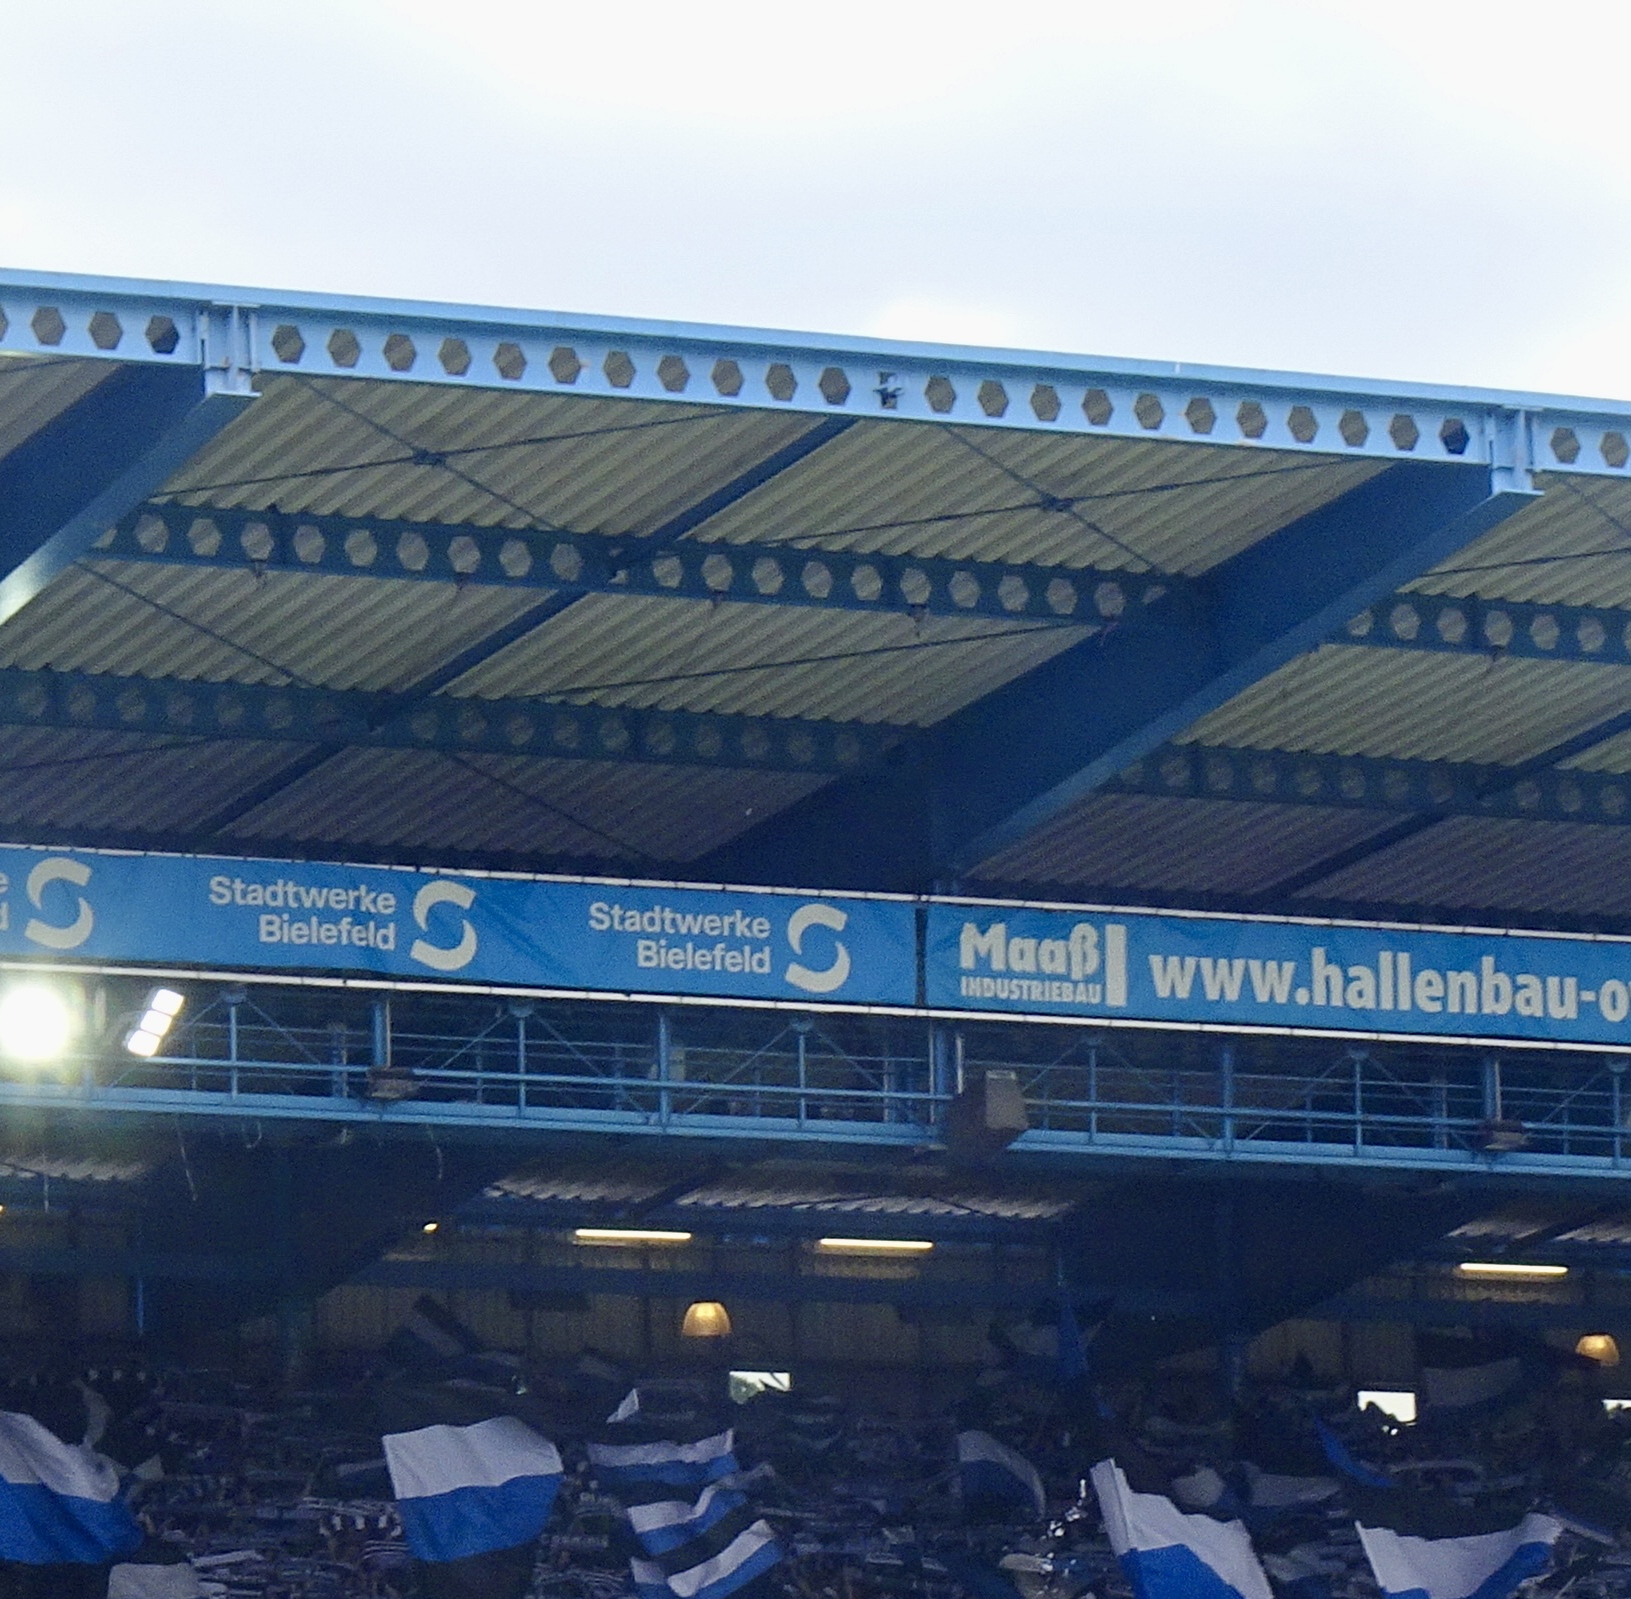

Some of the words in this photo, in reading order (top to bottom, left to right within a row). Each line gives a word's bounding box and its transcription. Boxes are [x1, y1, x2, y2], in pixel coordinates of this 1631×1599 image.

[208, 876, 397, 915] Stadtwerke
[258, 913, 396, 951] Bielefeld
[588, 901, 770, 938] Stadtwerke
[636, 938, 770, 974] Bielefeld
[959, 922, 1101, 981] Maaß
[960, 976, 1102, 1005] INDUSTRIEBAU
